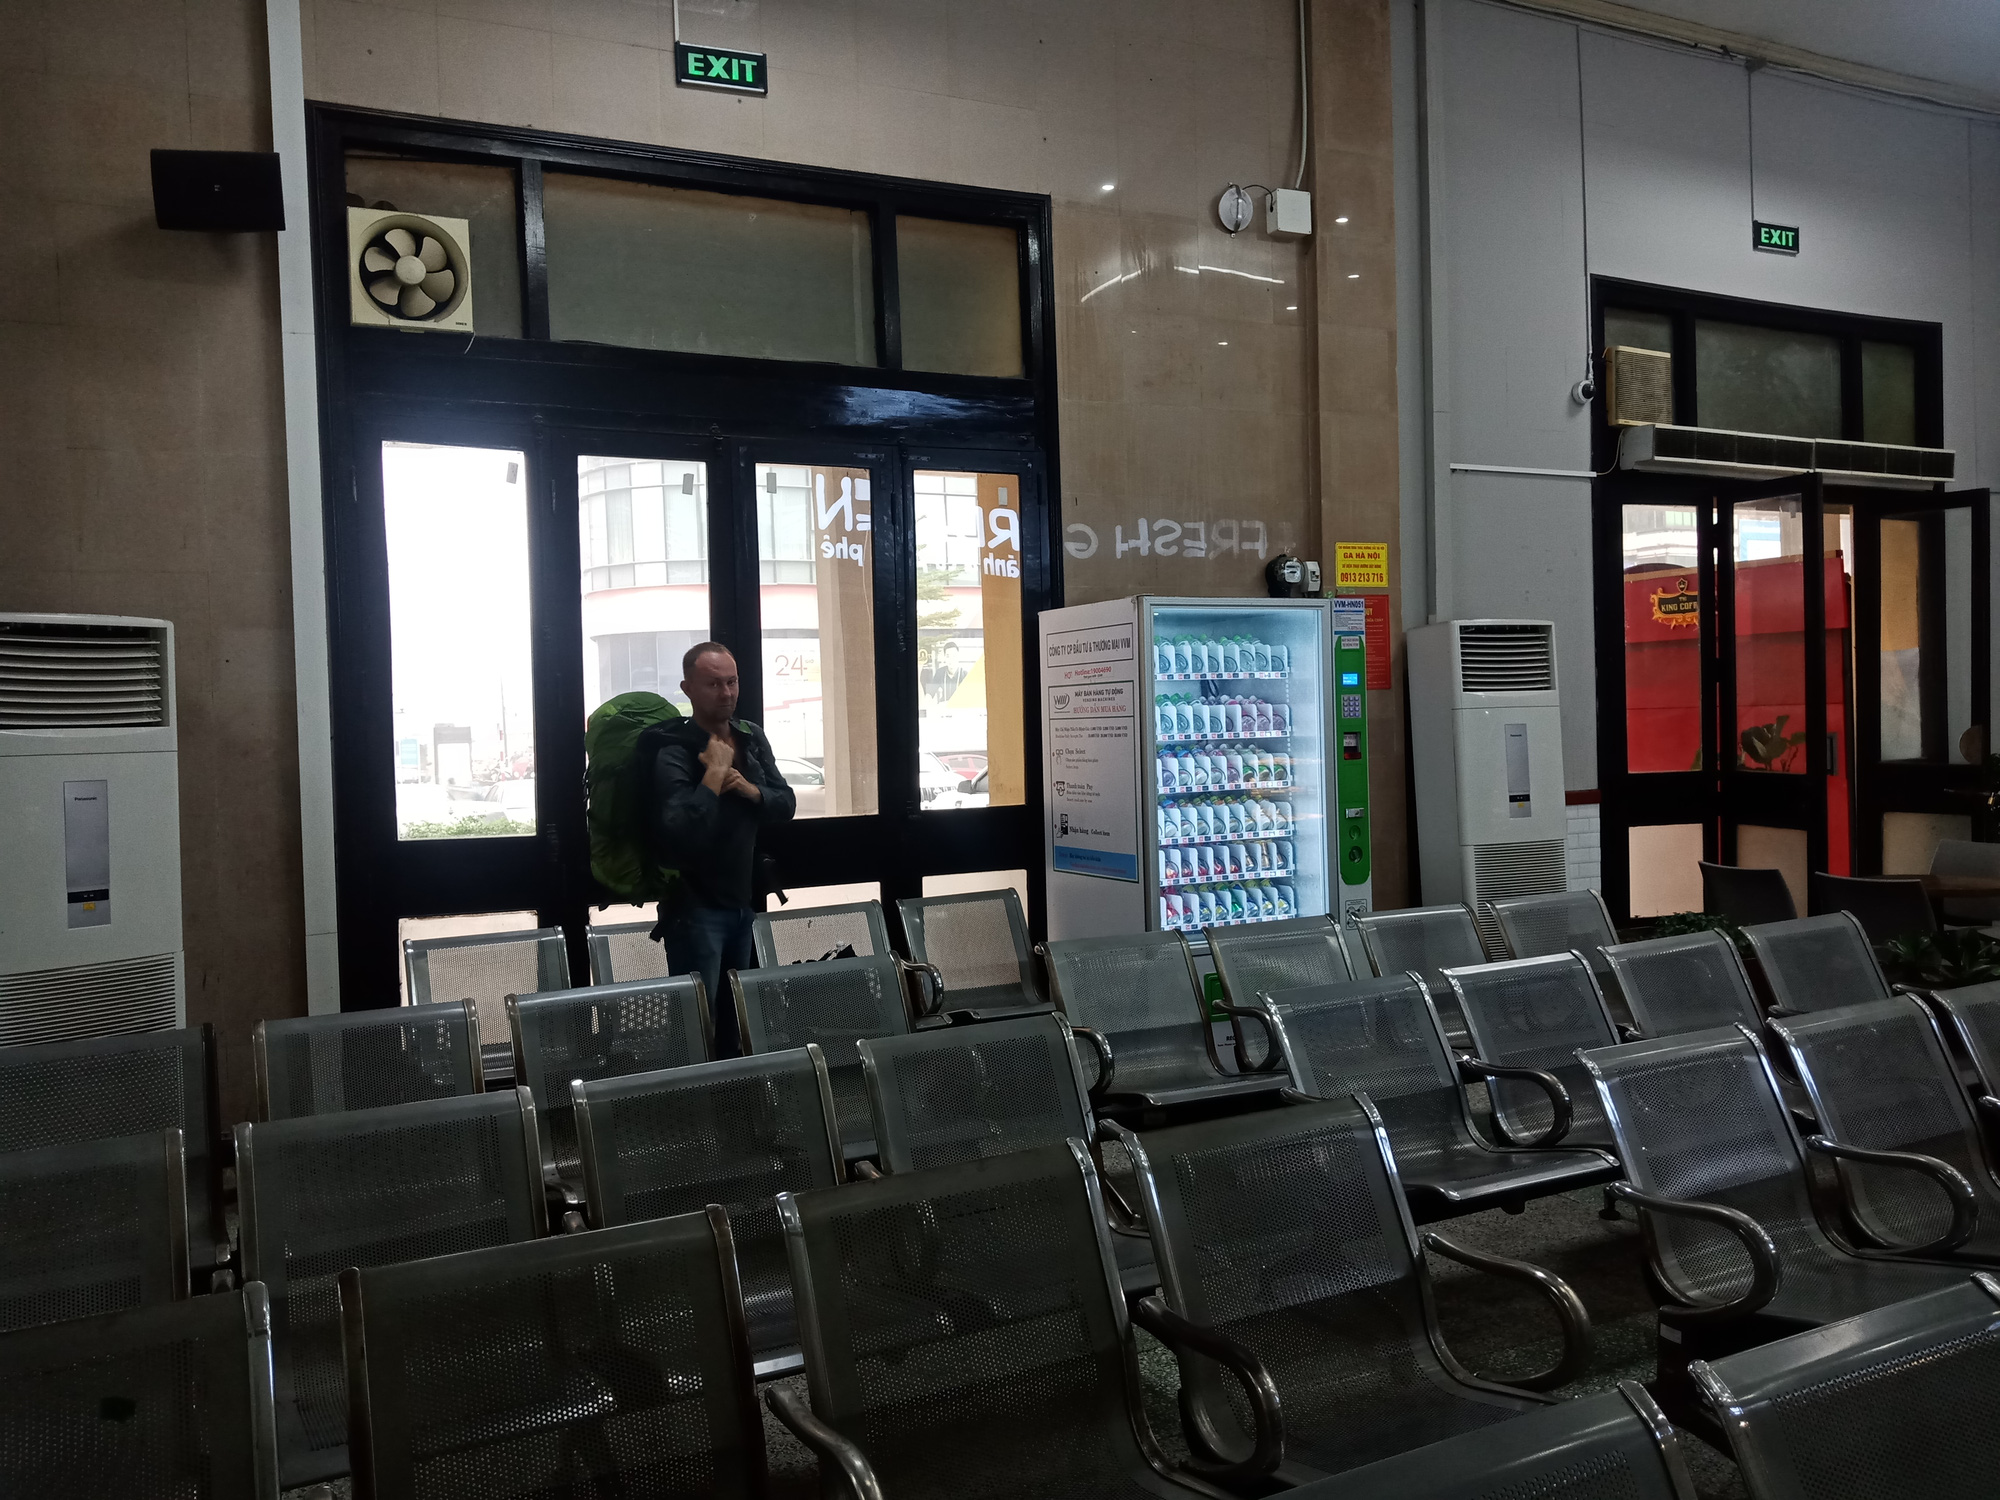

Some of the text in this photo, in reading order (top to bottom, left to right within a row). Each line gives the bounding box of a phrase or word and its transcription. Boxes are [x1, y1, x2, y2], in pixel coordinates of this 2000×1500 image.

[687, 52, 758, 83] EXIT
[1760, 227, 1795, 247] EXIT
[1355, 551, 1366, 559] HÀ
[1367, 551, 1381, 560] NỘI
[1340, 572, 1384, 583] 0913 213 716
[1334, 600, 1364, 608] VVM-HN051
[1661, 603, 1678, 612] KING
[1061, 645, 1066, 655] TY
[775, 654, 808, 676] 24
